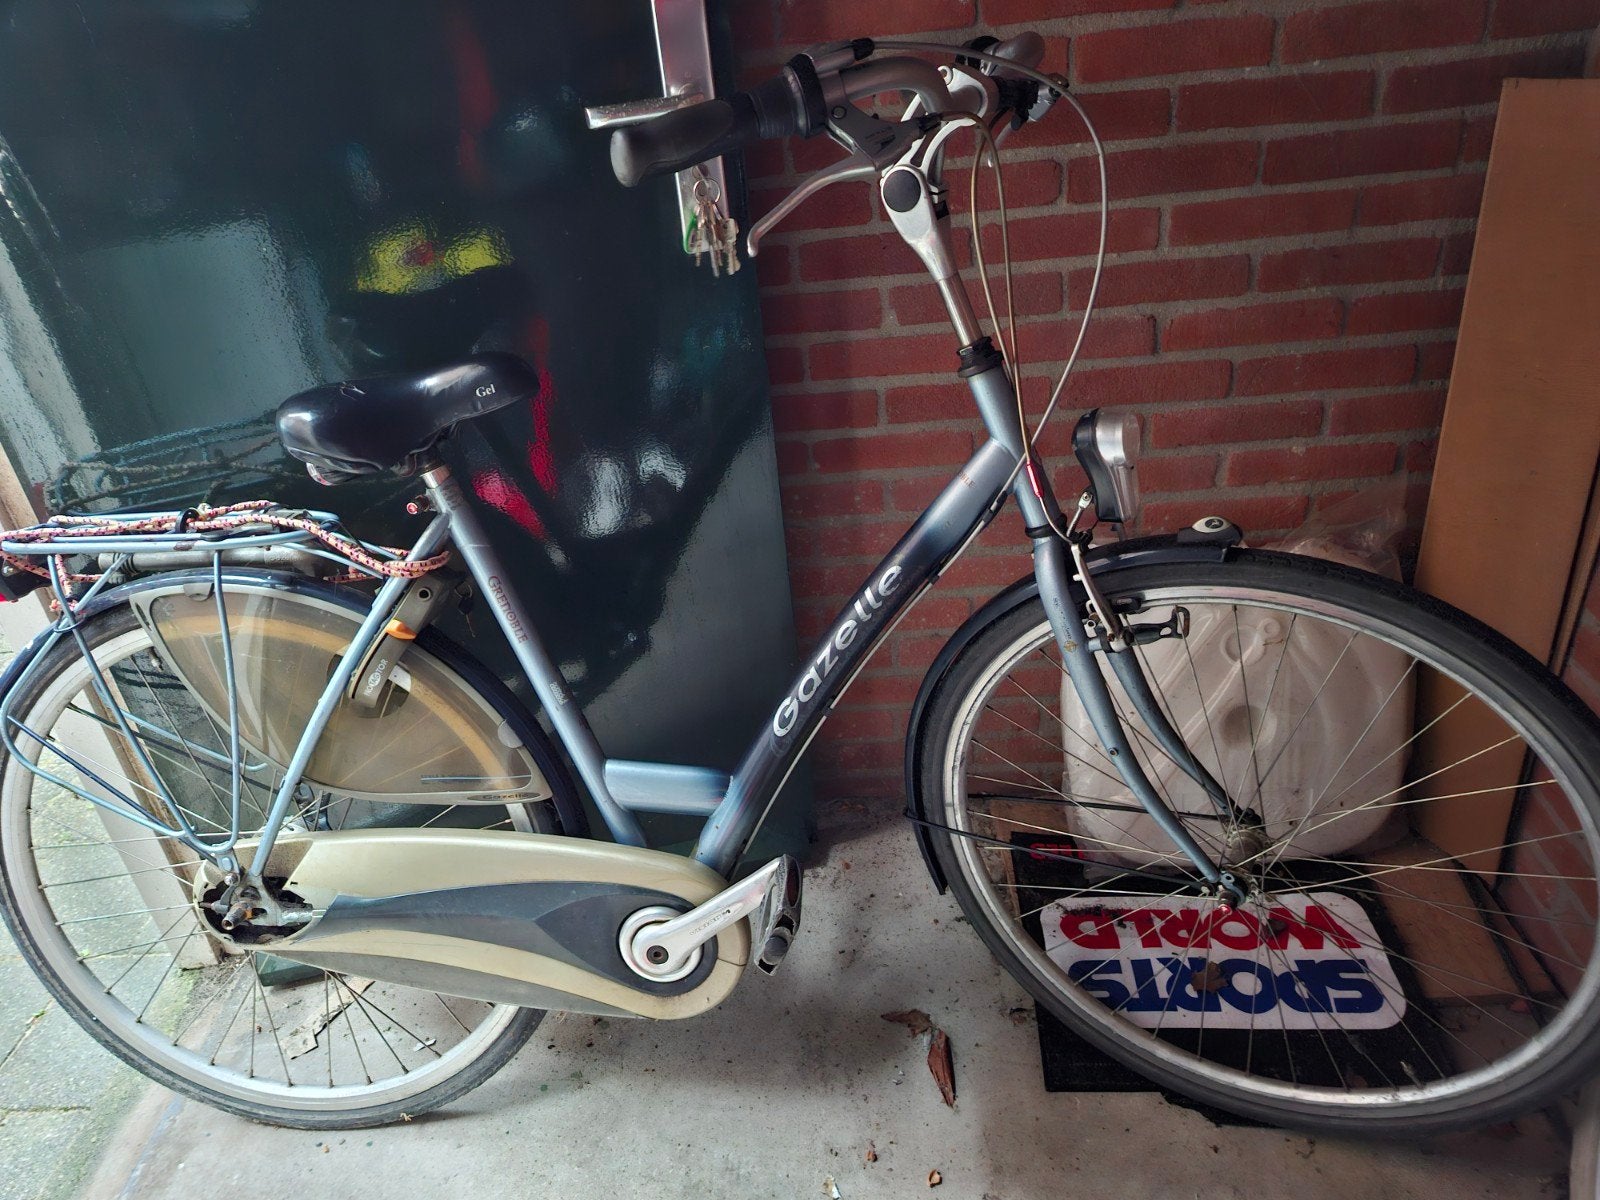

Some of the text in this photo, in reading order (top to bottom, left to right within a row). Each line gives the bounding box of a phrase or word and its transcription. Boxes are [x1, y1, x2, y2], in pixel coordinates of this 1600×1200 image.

[475, 383, 496, 398] Gel
[773, 565, 902, 737] Gazelle
[1059, 905, 1362, 951] WORLD
[1067, 957, 1385, 1014] SPORTS
